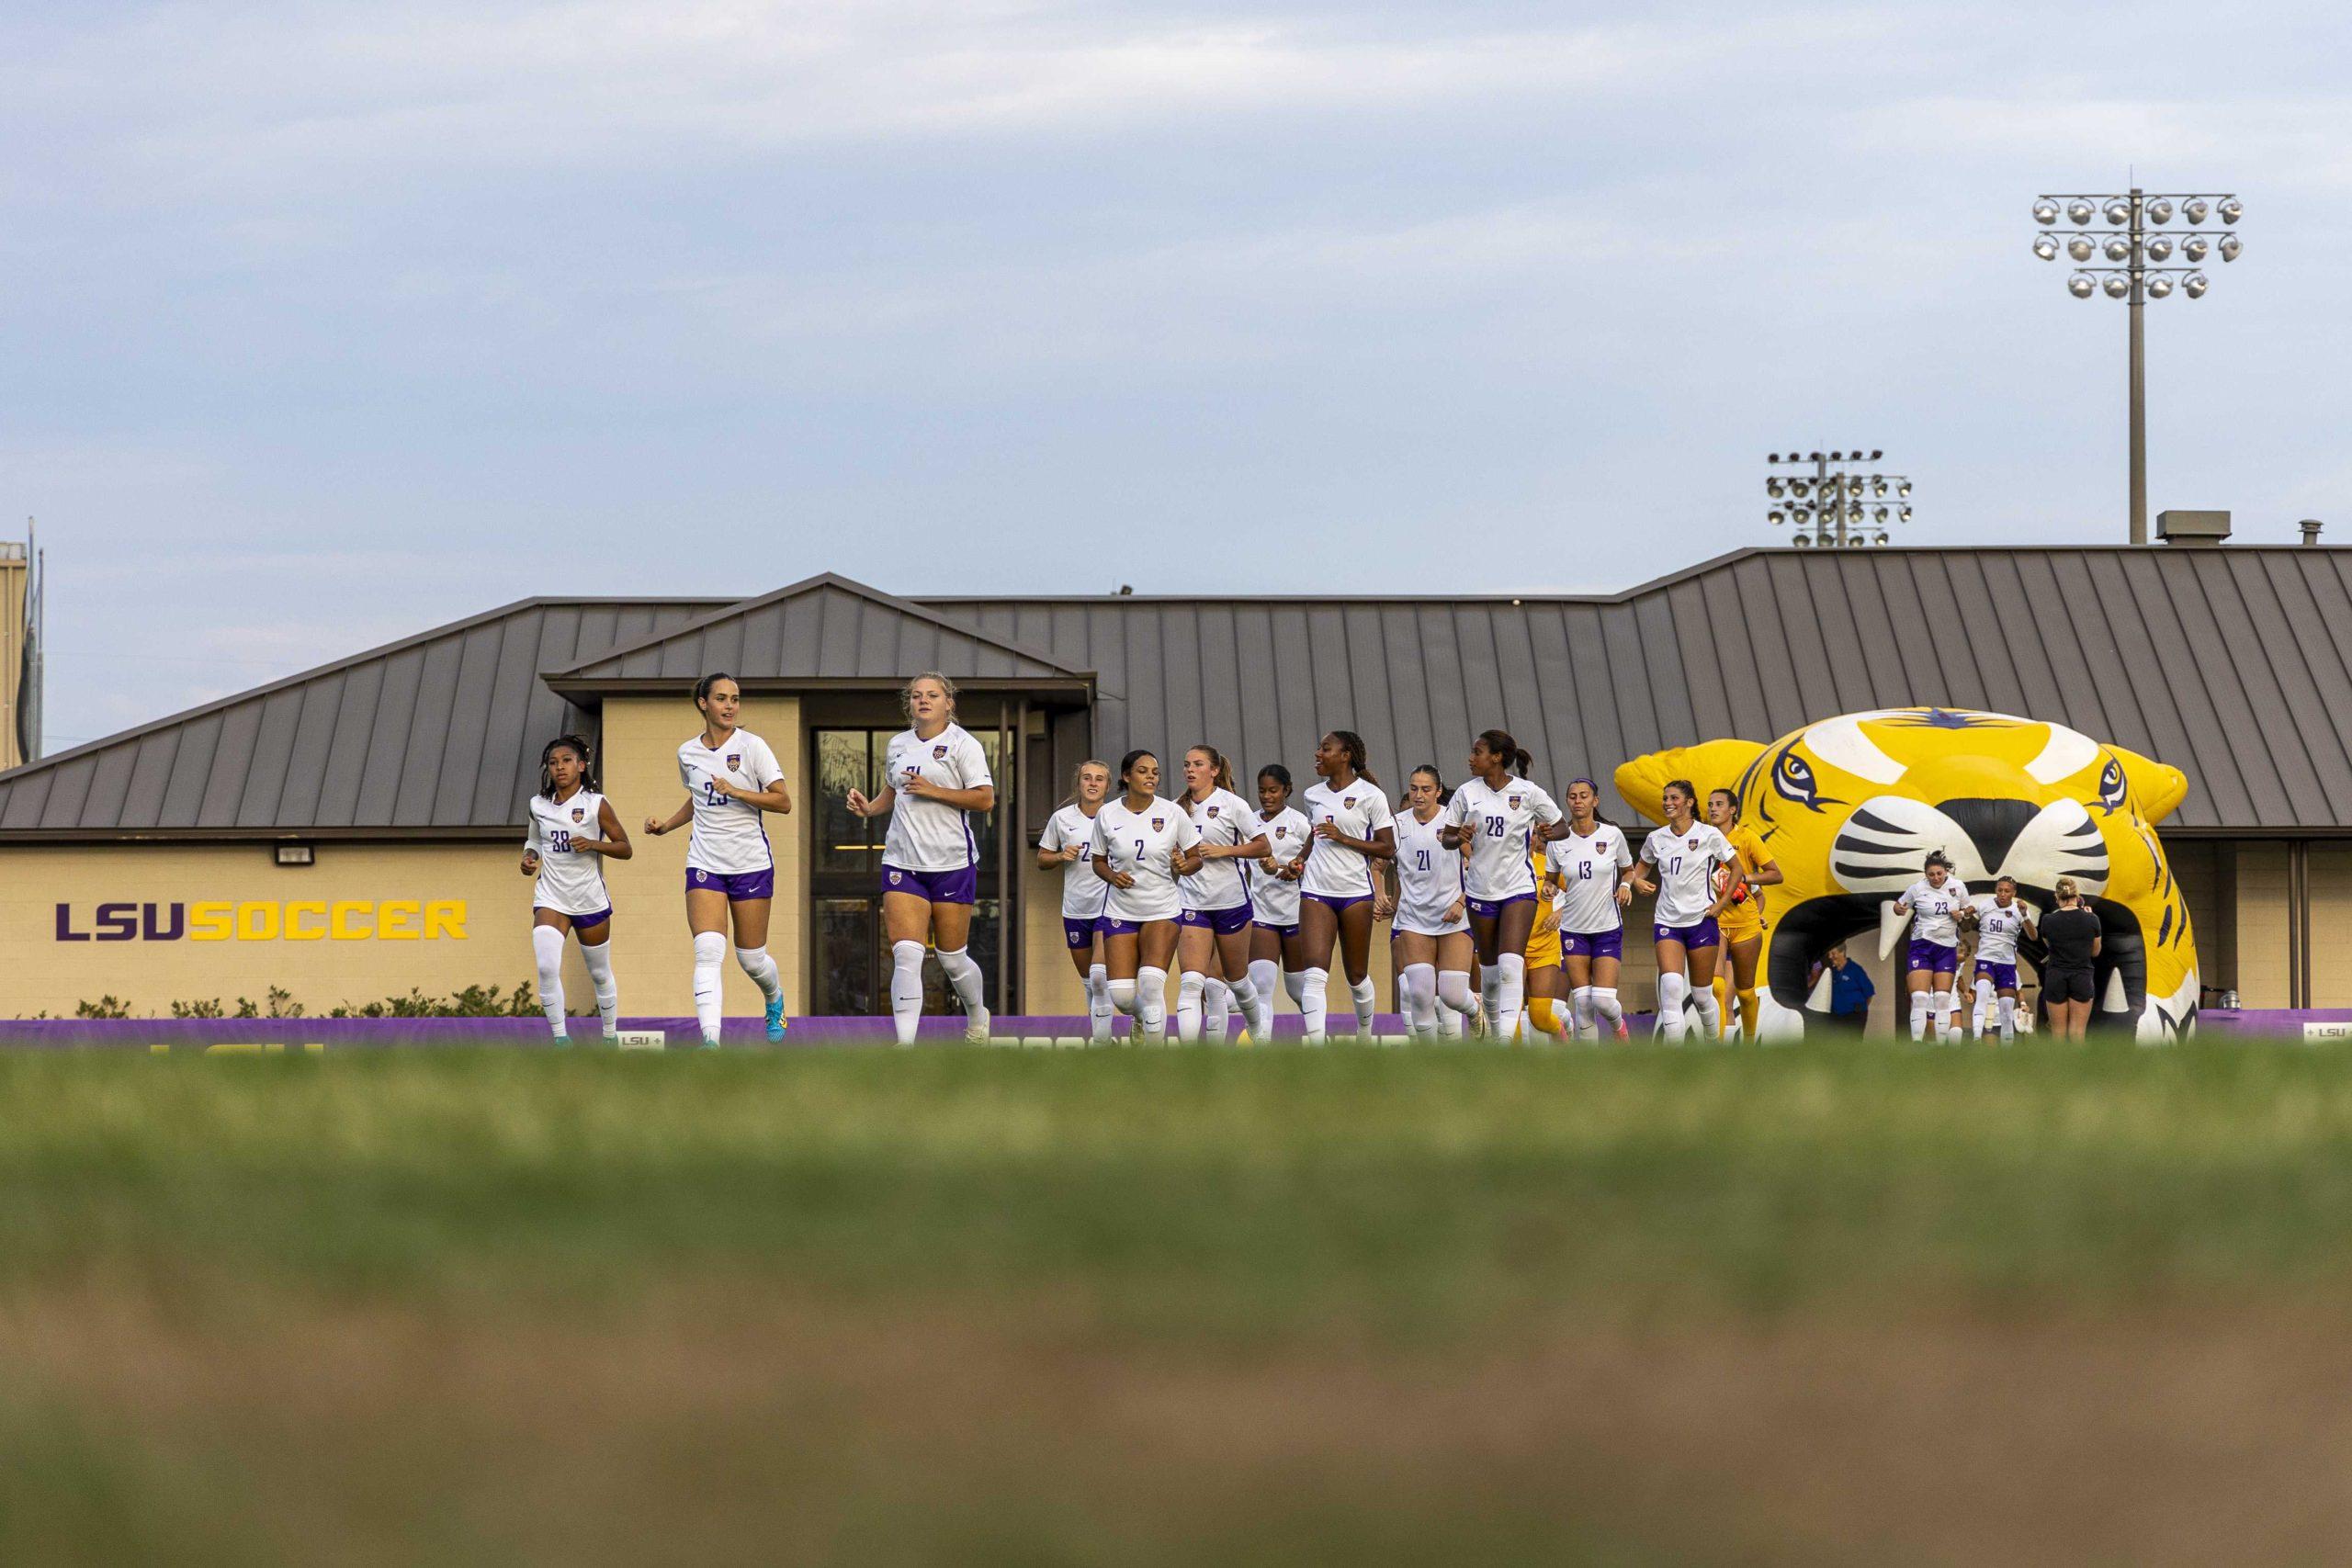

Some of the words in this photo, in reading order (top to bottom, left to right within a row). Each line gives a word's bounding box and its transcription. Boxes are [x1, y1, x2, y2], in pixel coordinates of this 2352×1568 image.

[1486, 817, 1504, 838] 28
[550, 829, 571, 852] 38
[1135, 840, 1146, 861] 2
[1416, 849, 1430, 872] 21
[1670, 856, 1682, 875] 17
[1578, 861, 1592, 880] 13
[1935, 901, 1949, 915] 23
[1989, 919, 2003, 933] 50
[621, 1036, 650, 1046] LSU
[2319, 1028, 2346, 1037] LSU
